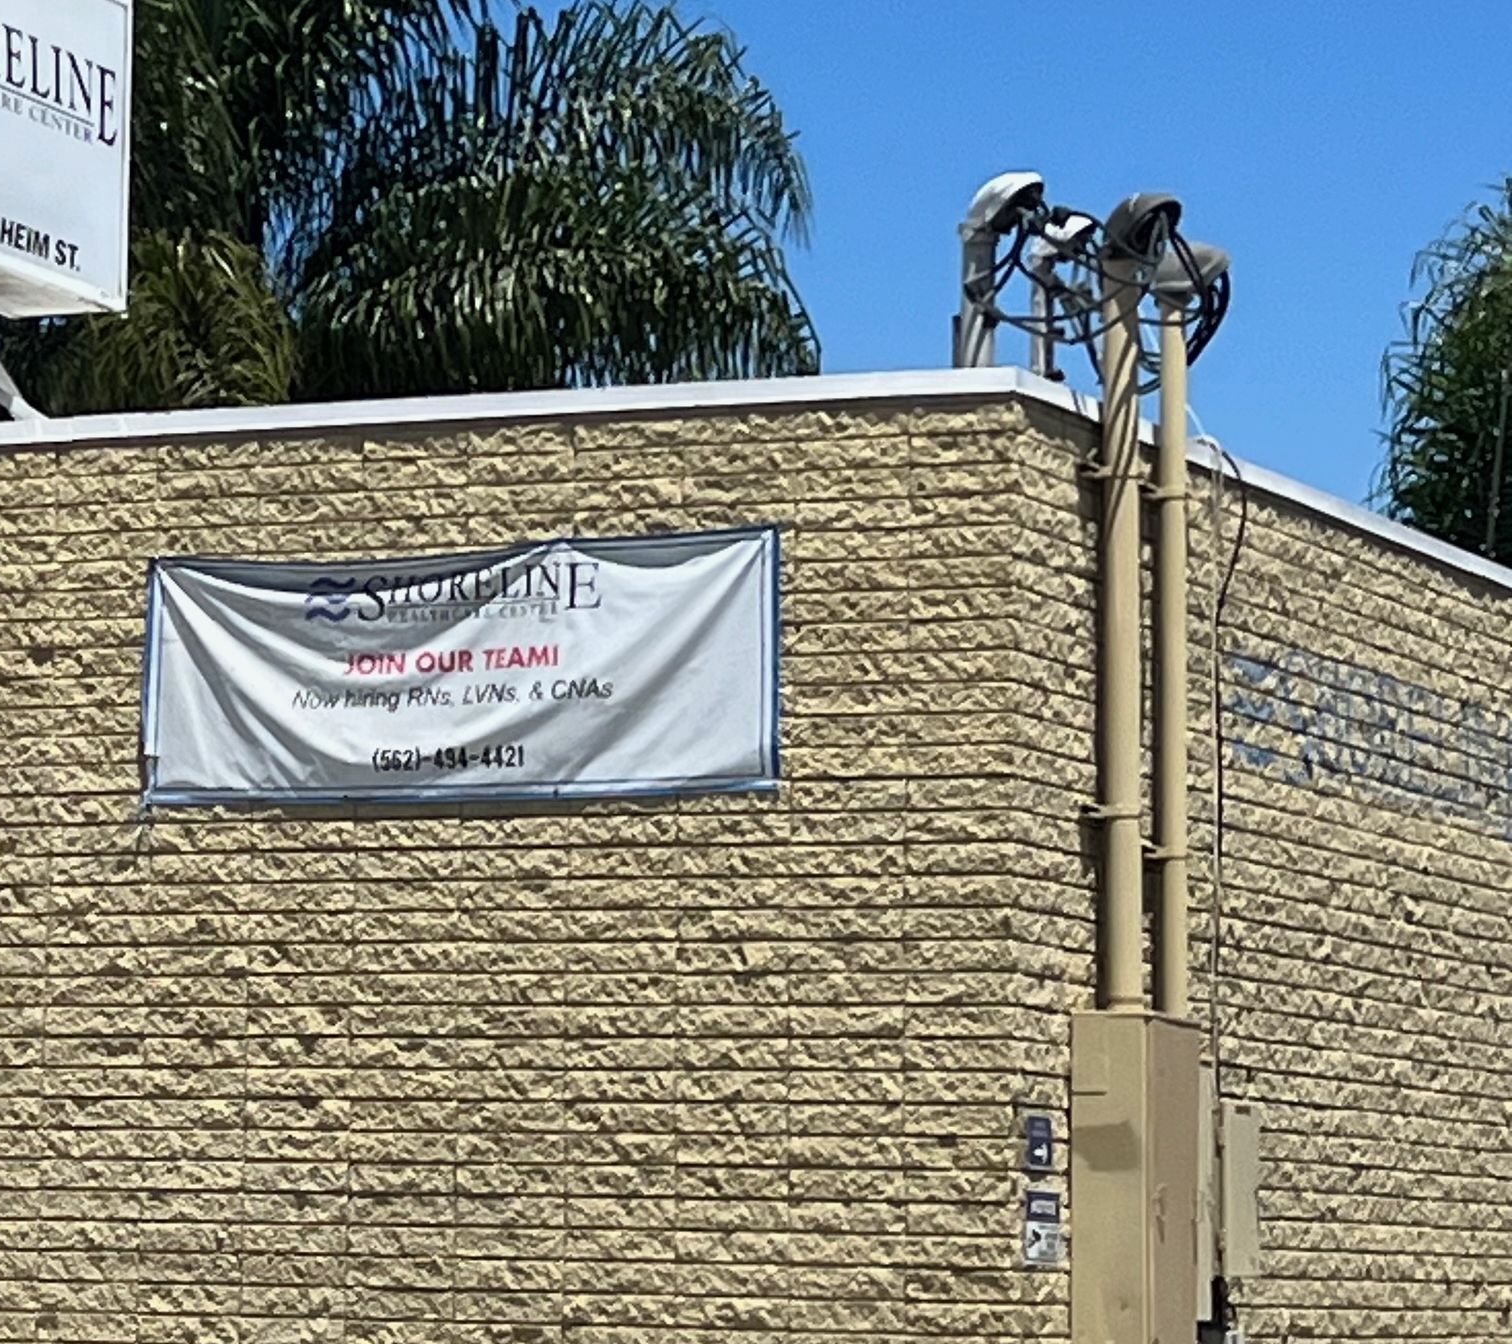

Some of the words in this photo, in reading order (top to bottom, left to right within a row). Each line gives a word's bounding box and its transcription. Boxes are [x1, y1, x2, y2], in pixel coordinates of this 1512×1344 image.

[28, 104, 93, 144] CENTER
[55, 239, 80, 271] ST.
[357, 561, 601, 622] SHORELINE
[344, 654, 405, 676] JOIN
[415, 650, 473, 673] OUR
[292, 688, 340, 710] Now
[344, 688, 400, 713] hiring
[529, 681, 543, 700] &
[551, 678, 613, 701] CNAs
